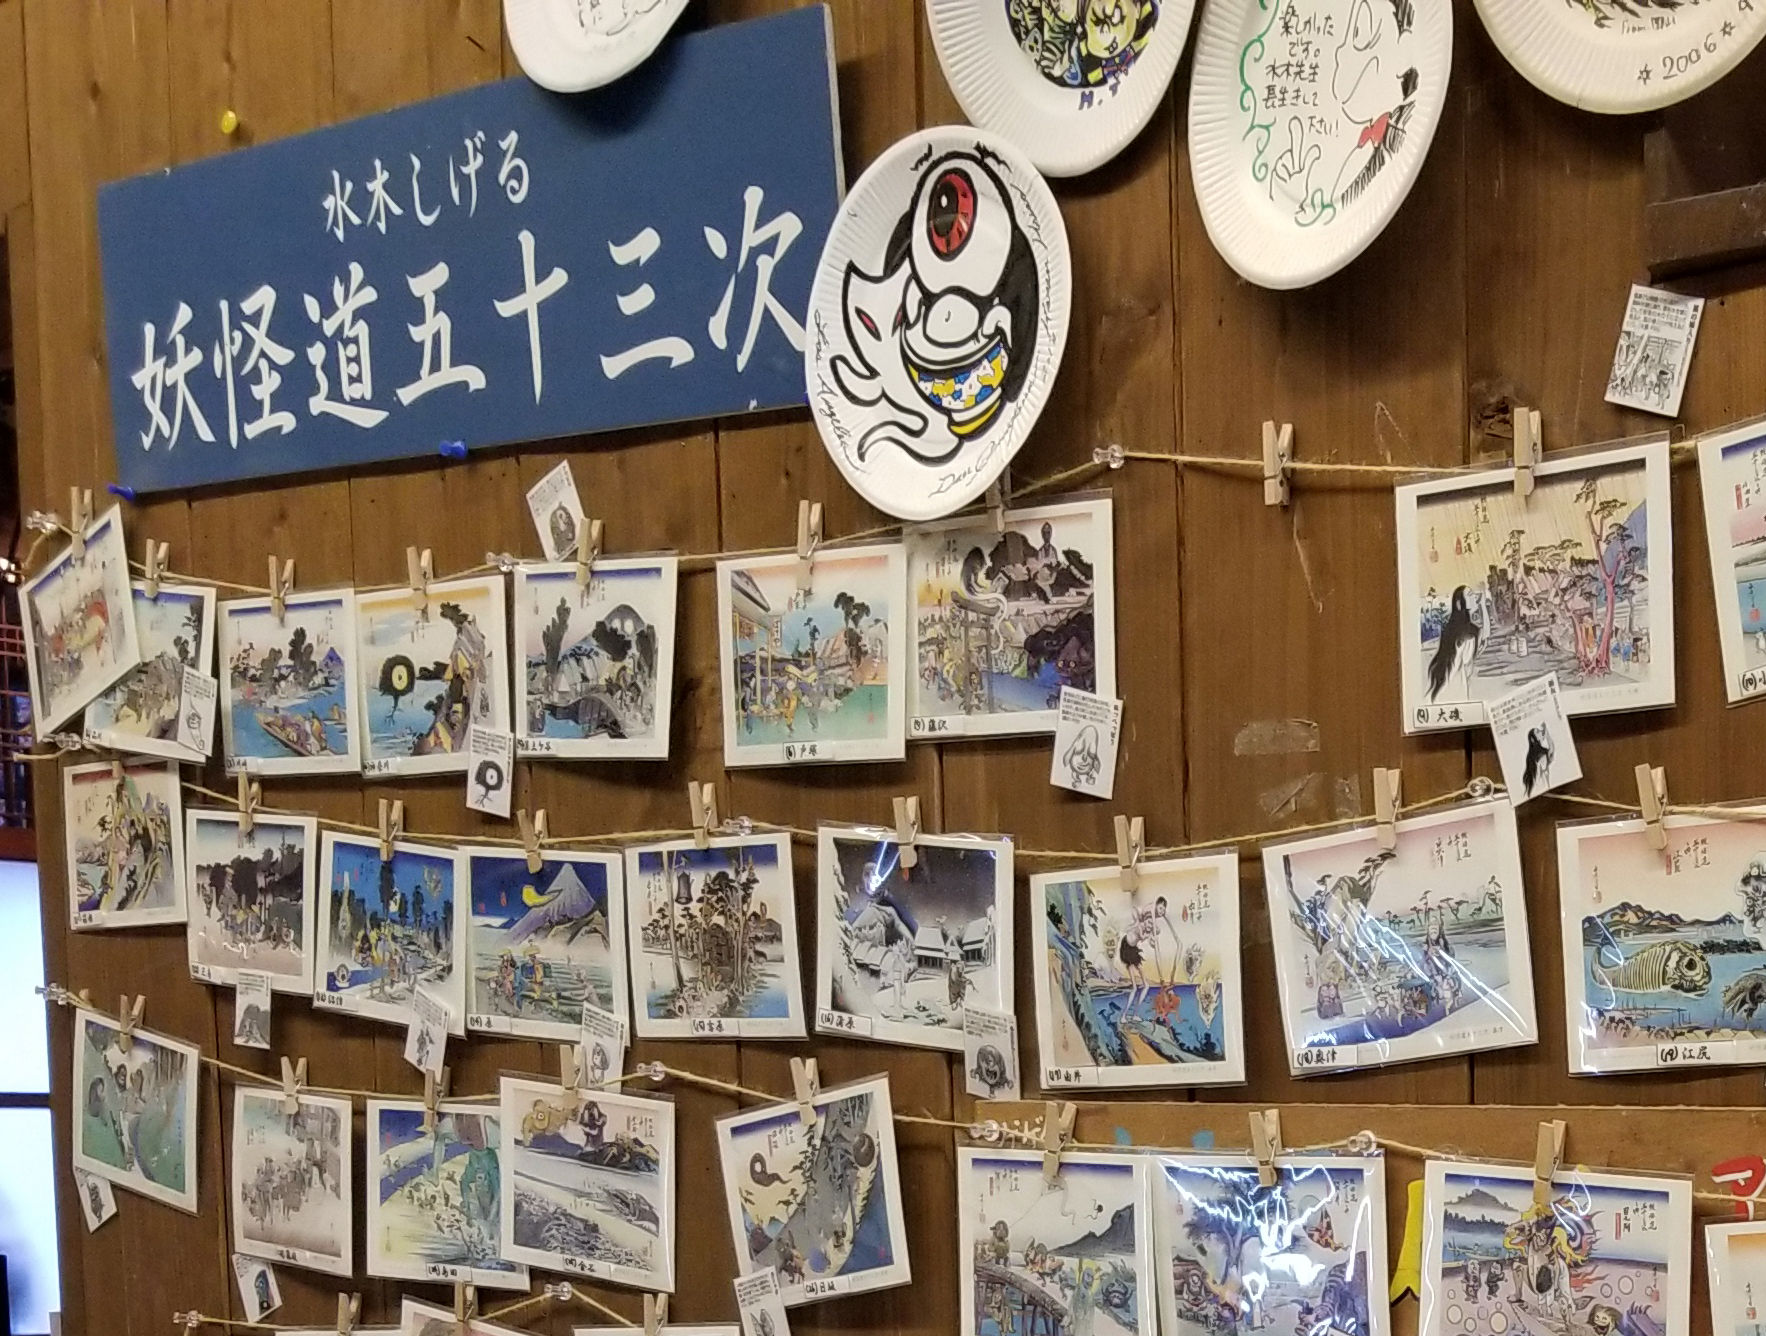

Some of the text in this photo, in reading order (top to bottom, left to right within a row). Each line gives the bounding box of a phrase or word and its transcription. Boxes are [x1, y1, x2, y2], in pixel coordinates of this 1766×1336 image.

[1265, 59, 1320, 86] 水木先生
[1662, 32, 1717, 80] 2006
[322, 129, 532, 243] 水木しげる
[131, 185, 808, 452] 妖怪道五十三次
